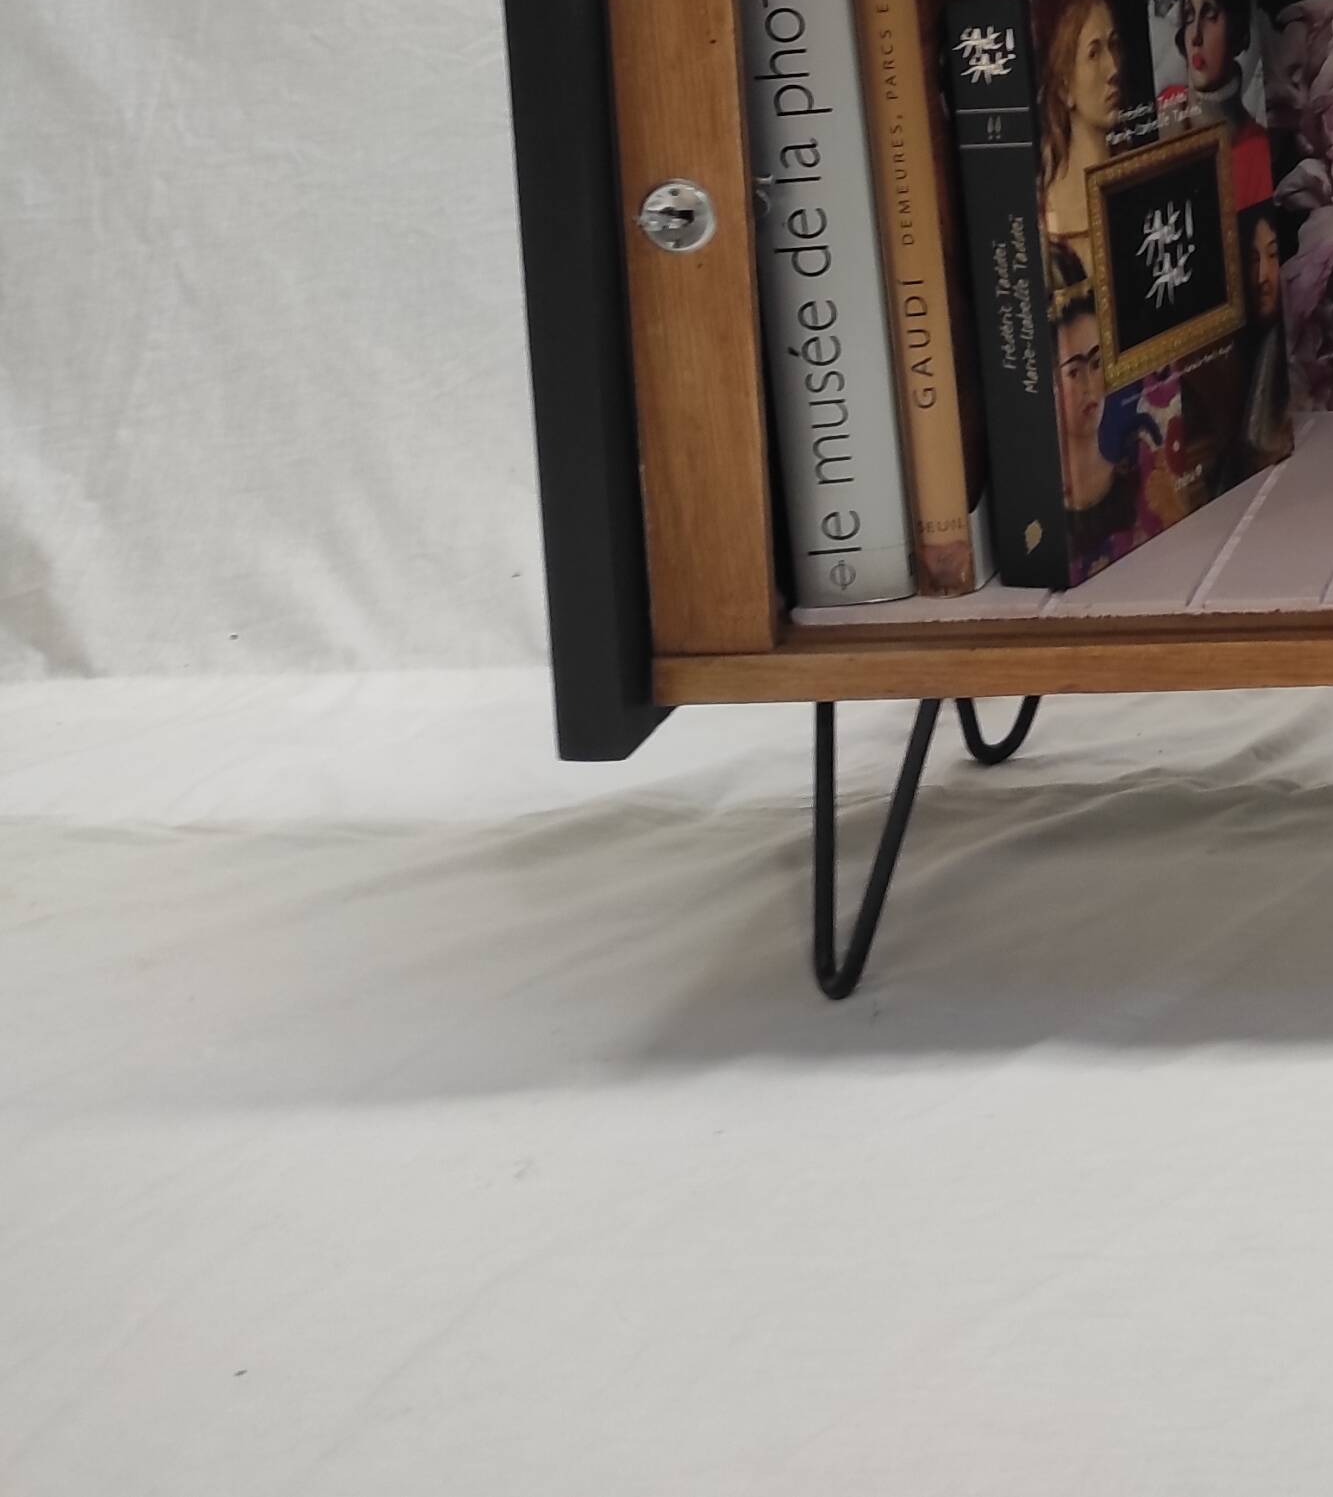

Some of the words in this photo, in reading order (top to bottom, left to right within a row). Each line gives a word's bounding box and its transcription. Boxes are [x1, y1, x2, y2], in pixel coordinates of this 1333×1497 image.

[880, 28, 899, 101] PARCS
[774, 137, 823, 185] la
[774, 207, 833, 278] de
[787, 299, 855, 486] musée
[807, 510, 863, 557] le
